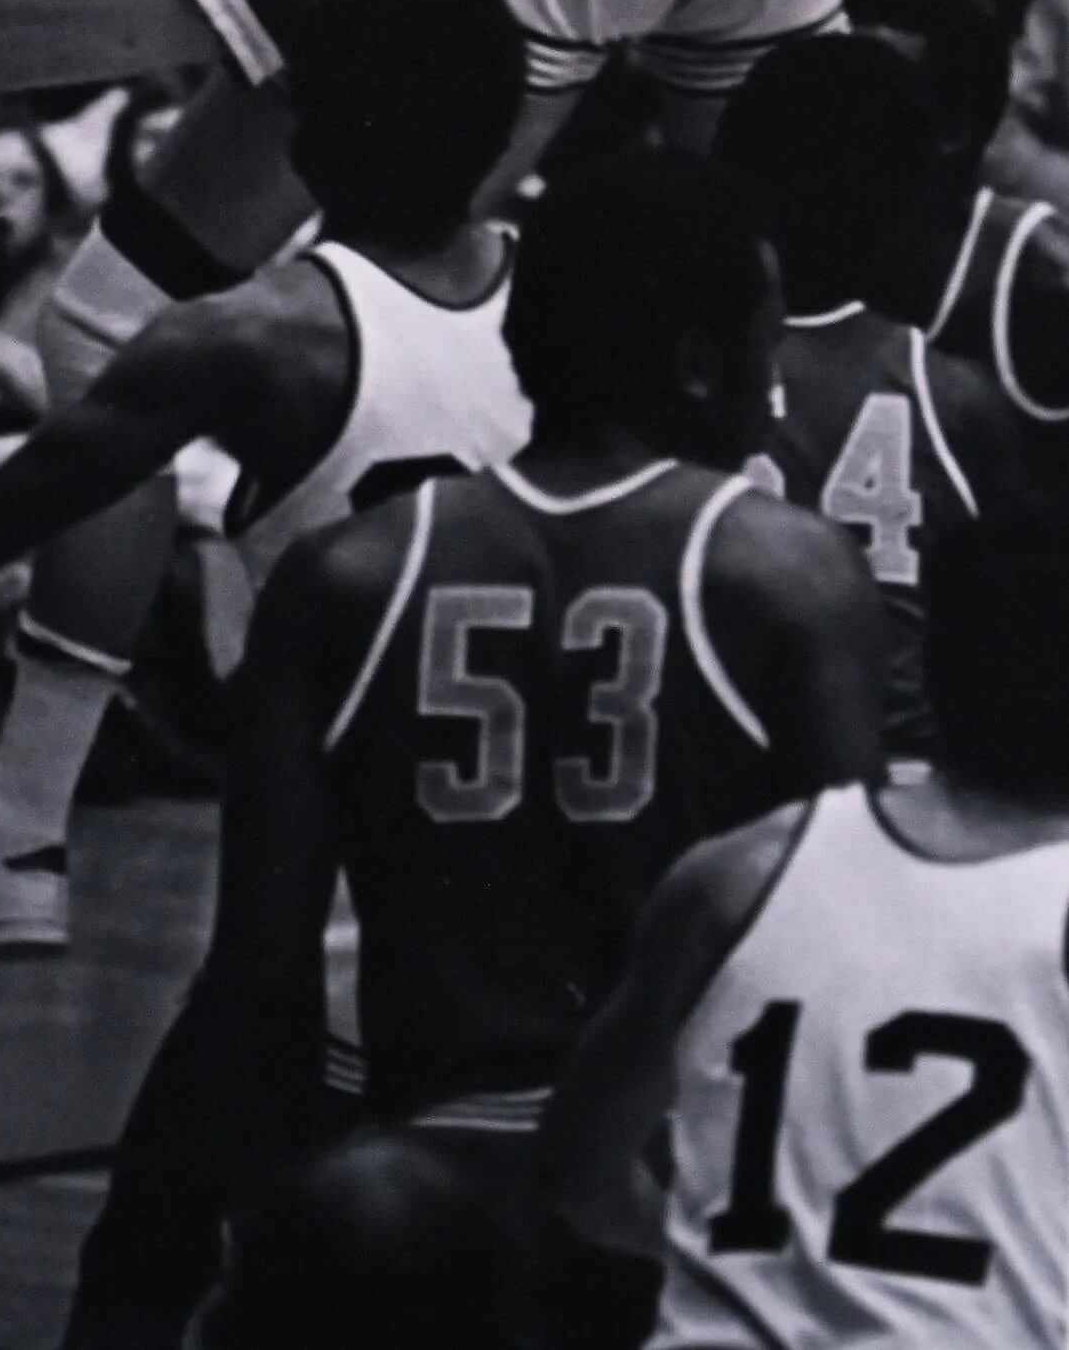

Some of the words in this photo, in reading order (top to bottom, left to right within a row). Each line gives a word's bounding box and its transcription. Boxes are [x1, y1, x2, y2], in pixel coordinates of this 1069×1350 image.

[743, 392, 923, 586] 4
[415, 584, 669, 823] 53
[708, 1001, 1028, 1287] 12
